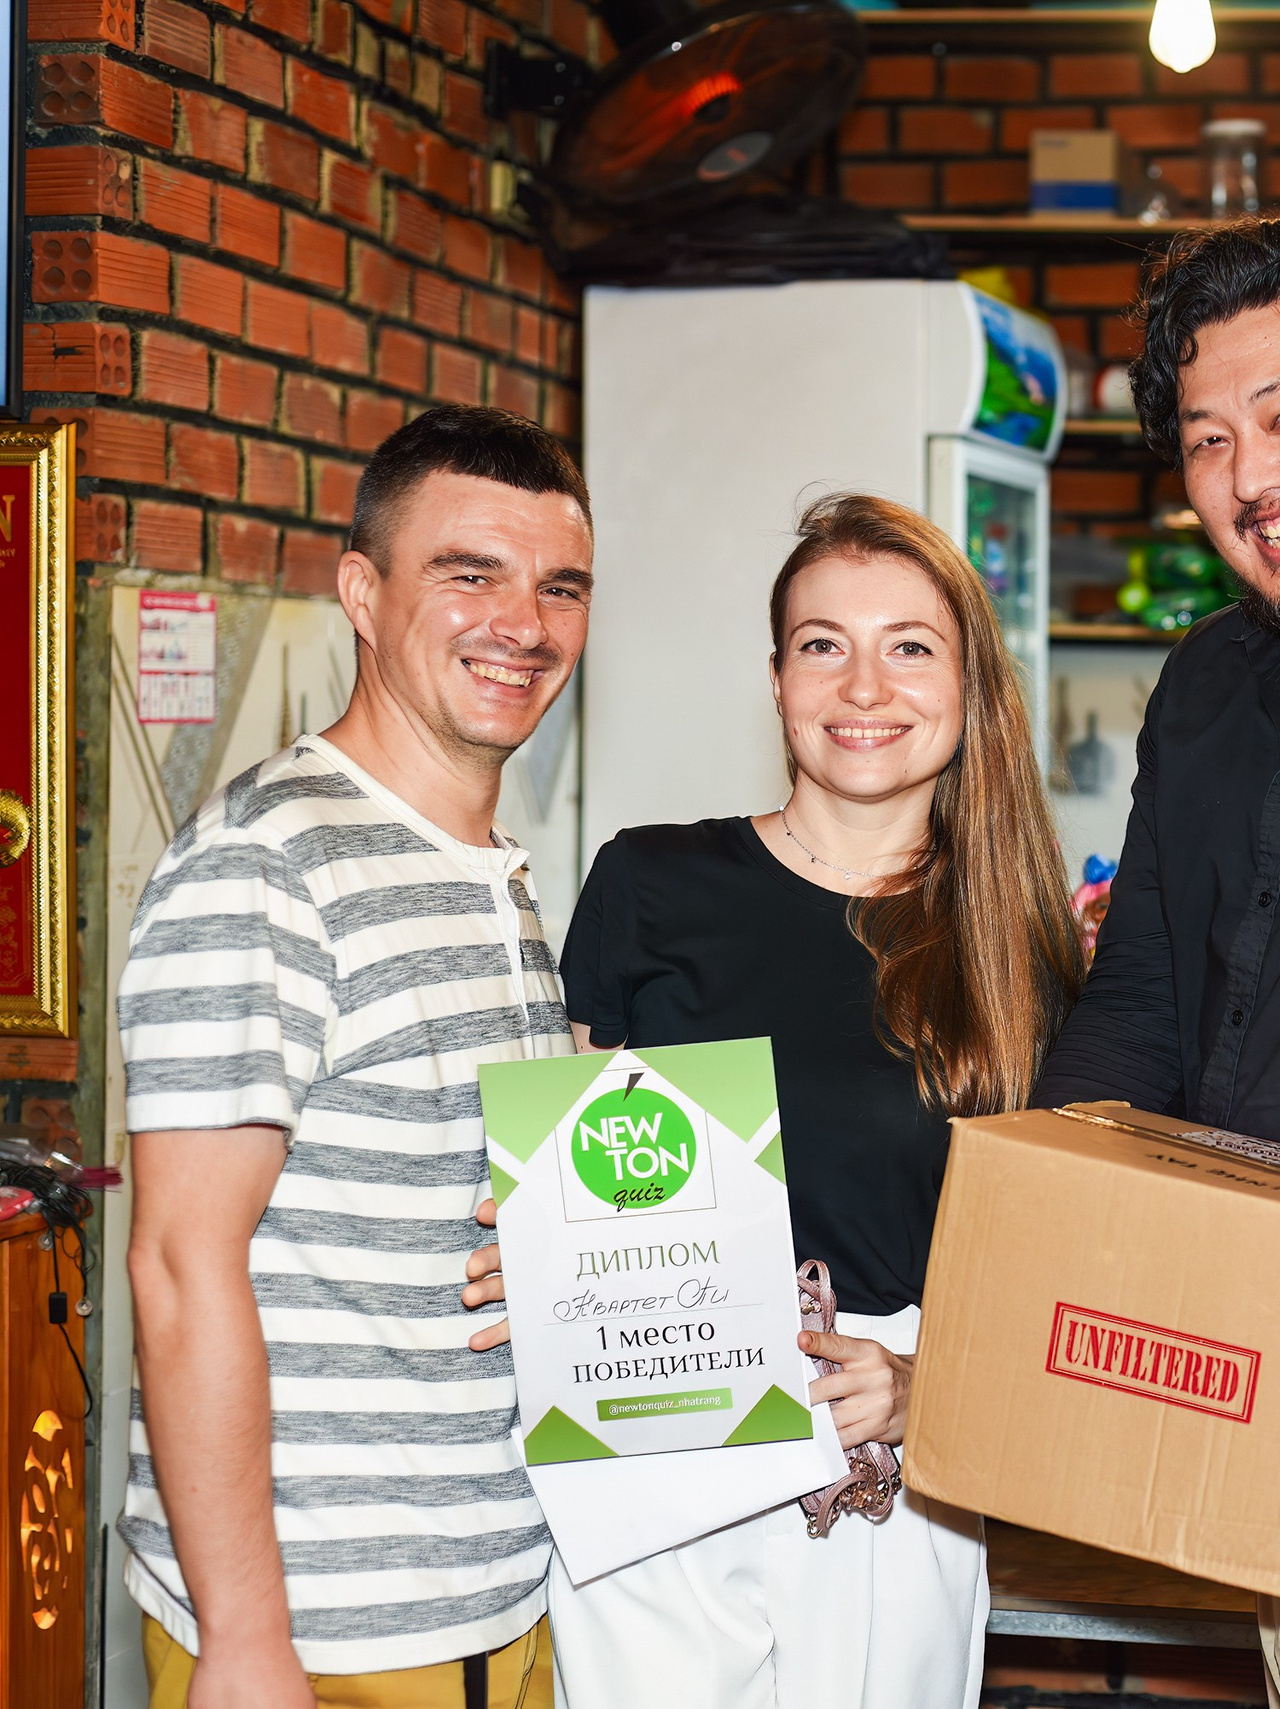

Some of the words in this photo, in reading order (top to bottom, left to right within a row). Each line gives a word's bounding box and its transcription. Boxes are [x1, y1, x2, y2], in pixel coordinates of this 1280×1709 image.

[579, 1112, 663, 1151] NEW
[605, 1143, 690, 1181] TON
[613, 1183, 666, 1212] quiz
[576, 1240, 721, 1281] ДИПЛОМ
[596, 1325, 608, 1350] 1
[619, 1322, 715, 1349] место
[572, 1347, 766, 1383] ПОБЕДИТЕЛИ
[1065, 1320, 1239, 1403] UNFILTERED
